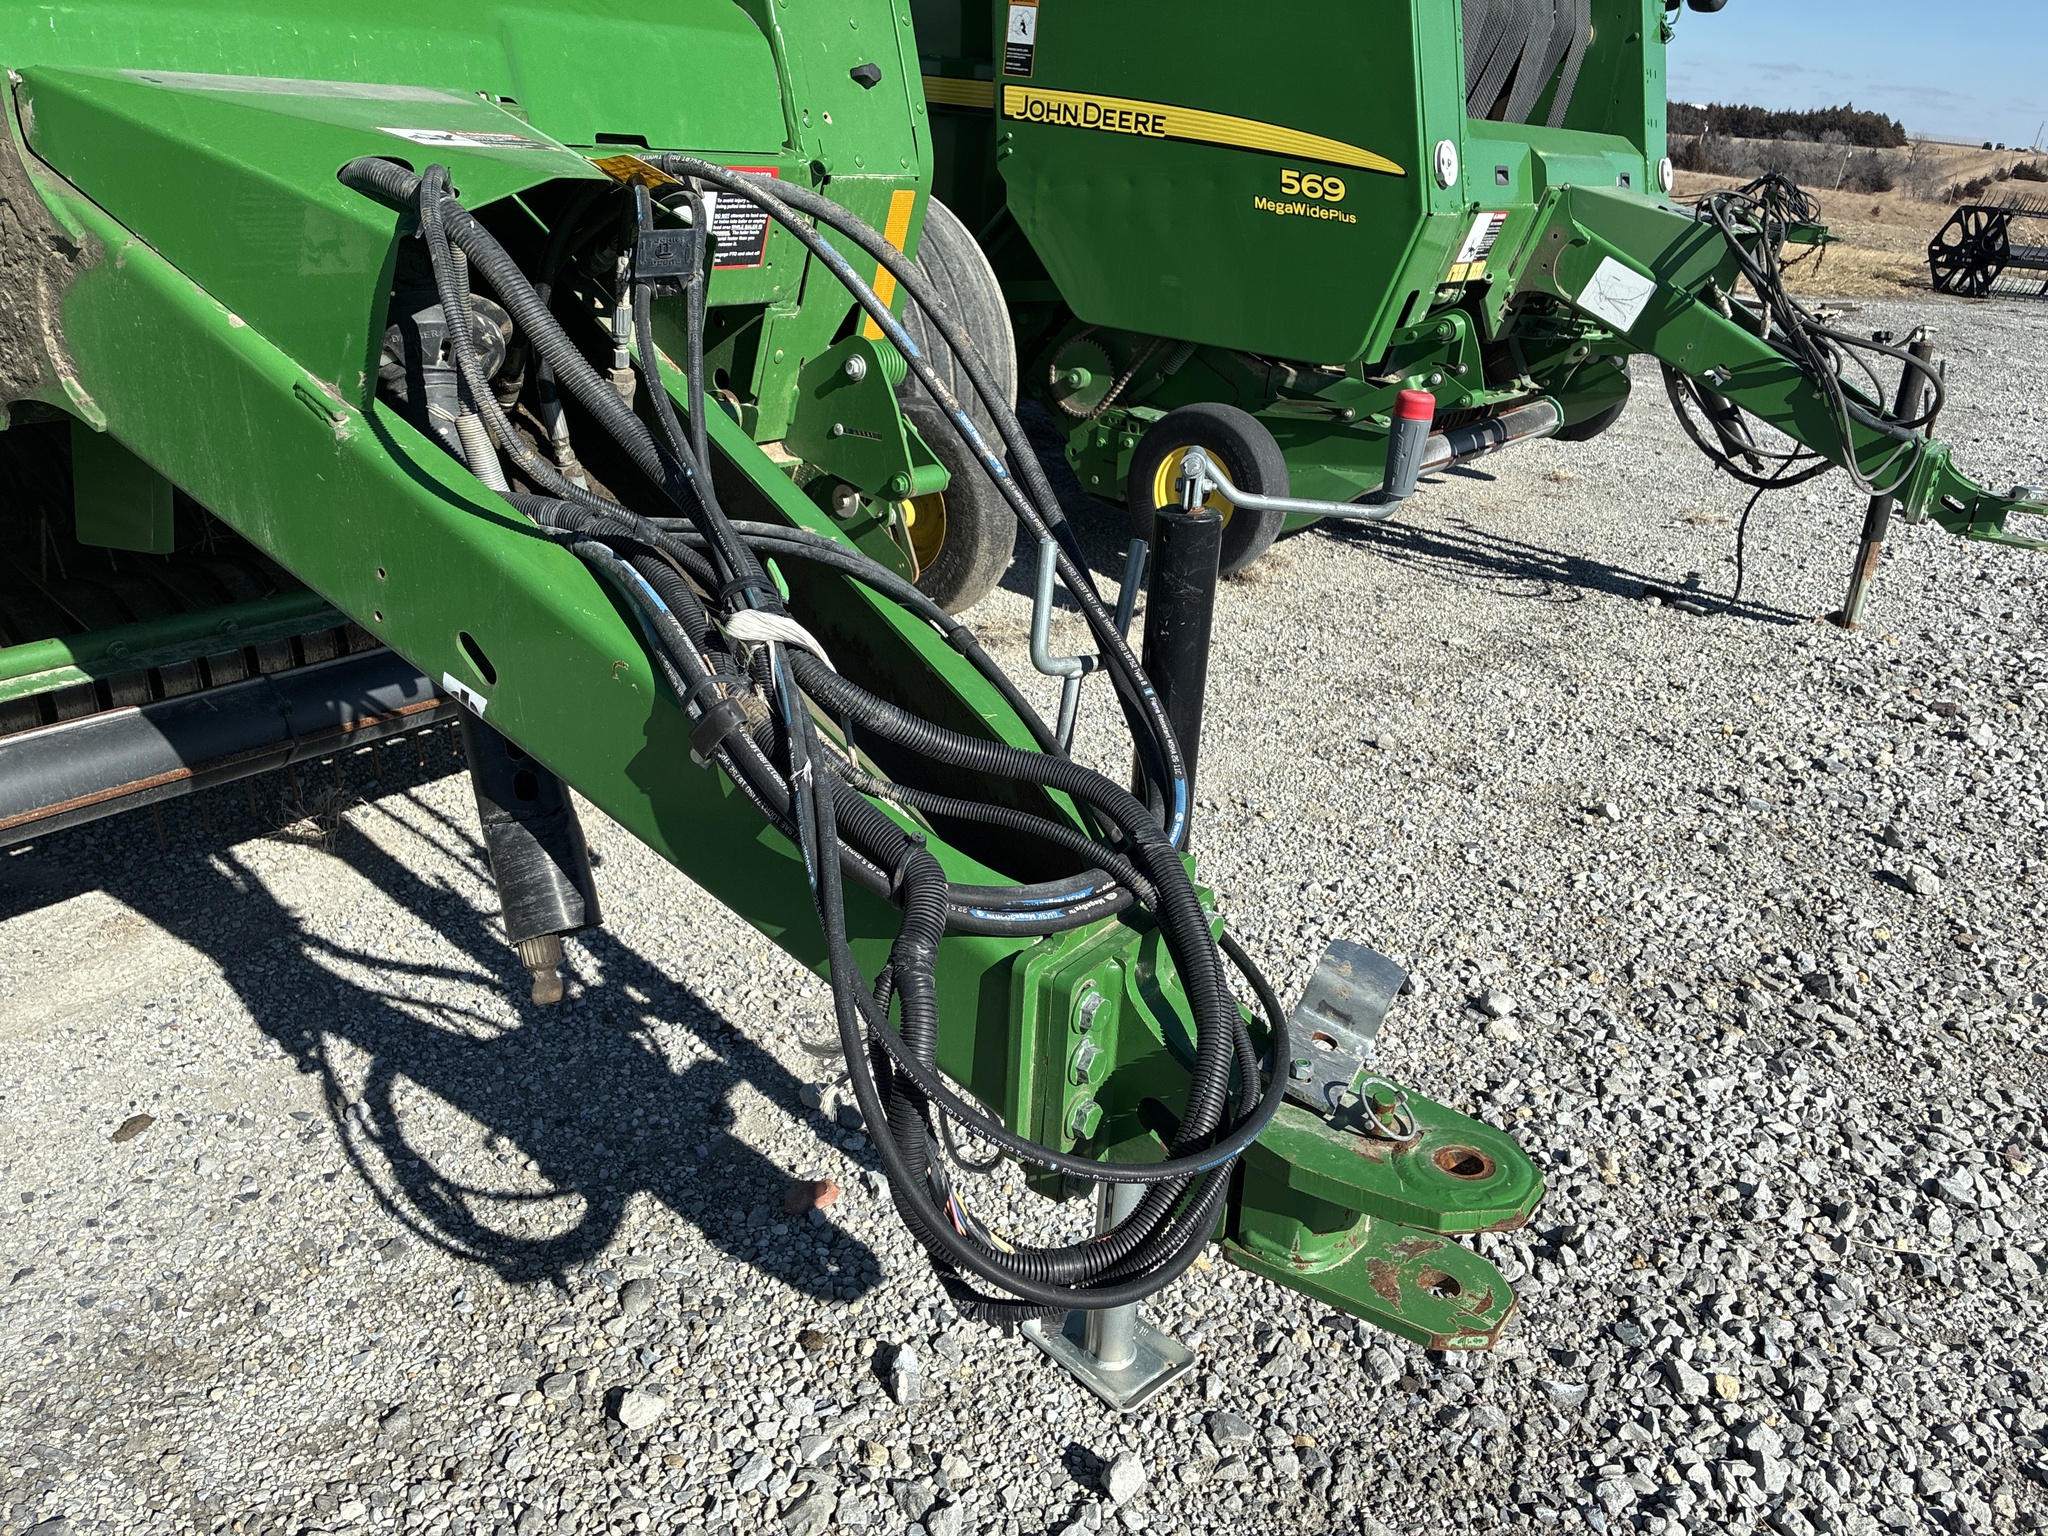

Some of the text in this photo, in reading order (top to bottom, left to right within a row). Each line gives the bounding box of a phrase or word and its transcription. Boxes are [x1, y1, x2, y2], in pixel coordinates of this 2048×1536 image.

[1015, 95, 1166, 135] JOHN DEERE
[1281, 169, 1345, 202] 569
[1254, 196, 1357, 224] MegaWidePlus
[1085, 591, 1097, 605] R17
[1095, 606, 1106, 619] SAE
[1123, 650, 1139, 669] 18752
[1133, 666, 1144, 683] Type
[1166, 738, 1177, 755] MSHA
[728, 767, 746, 787] 18752
